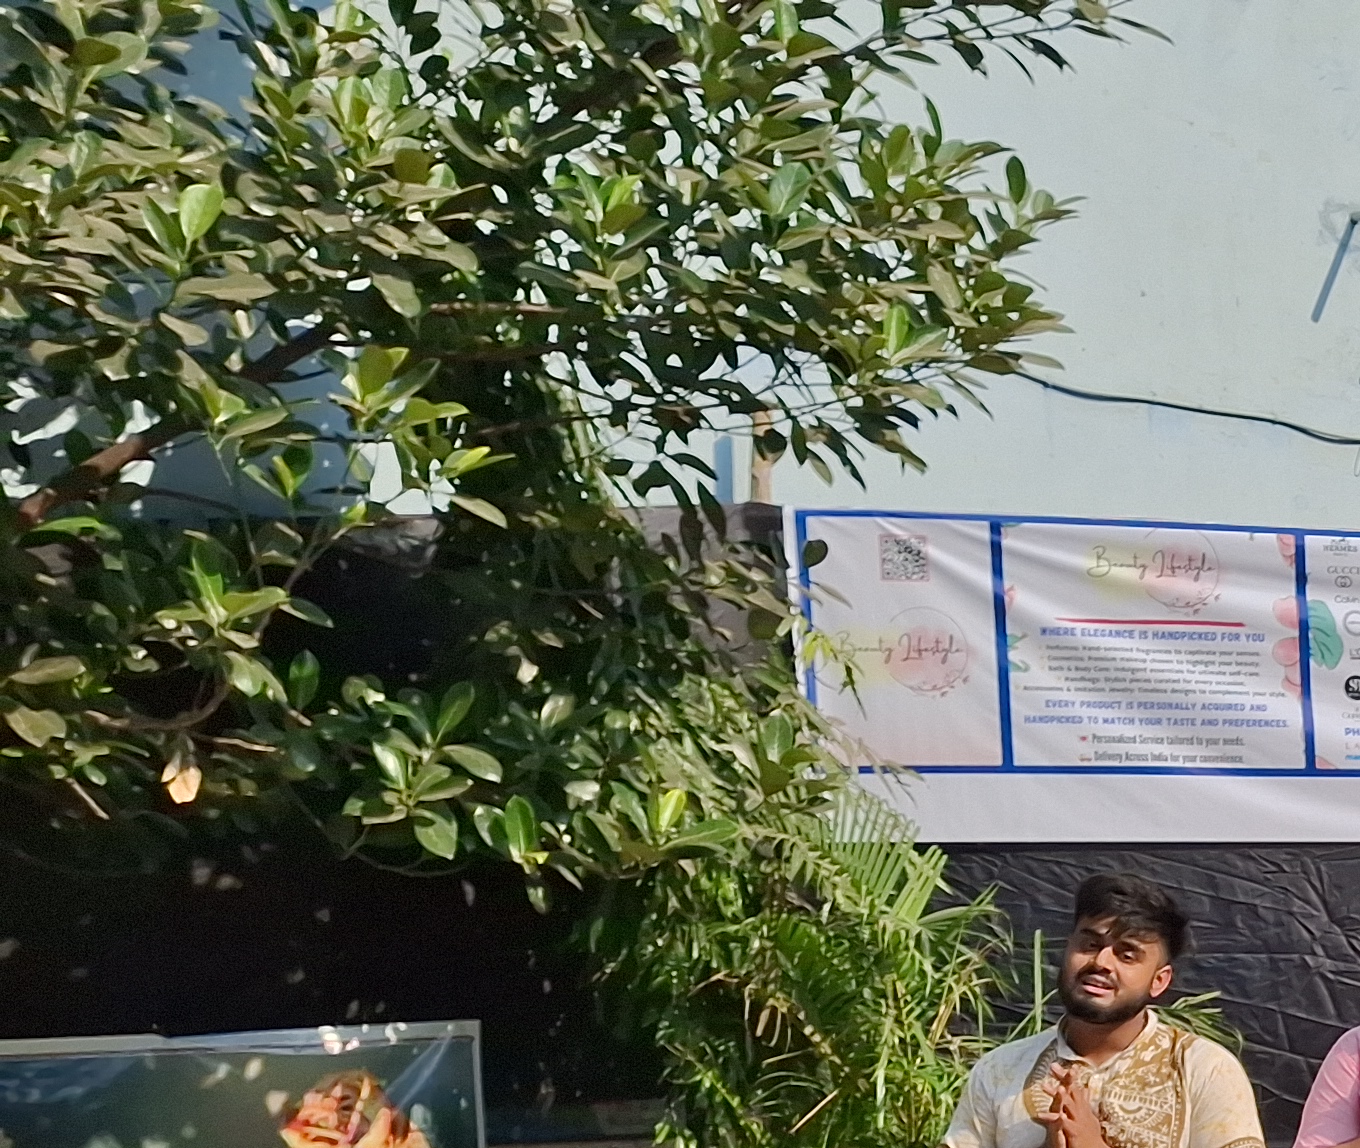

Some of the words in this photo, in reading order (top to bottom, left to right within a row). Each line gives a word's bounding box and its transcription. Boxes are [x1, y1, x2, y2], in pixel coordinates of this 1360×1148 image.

[1040, 627, 1077, 637] WHERE
[1080, 628, 1135, 639] ELEGANCE
[1138, 630, 1149, 640] IS
[1151, 631, 1217, 642] HANDPICKED
[1220, 632, 1241, 642] FOR
[1244, 633, 1266, 643] YOU
[1044, 699, 1076, 709] EVERY
[1079, 700, 1122, 710] PRODUCT
[1136, 701, 1197, 711] PERSONALLY
[1200, 703, 1246, 712] ACQUIRED
[1249, 704, 1269, 712] AND
[1023, 714, 1084, 725] HANDPICKED
[1086, 716, 1100, 725] TO
[1102, 717, 1136, 725] MATCH
[1138, 717, 1164, 727] YOUR
[1166, 718, 1198, 727] TASTE
[1200, 718, 1219, 727] AND
